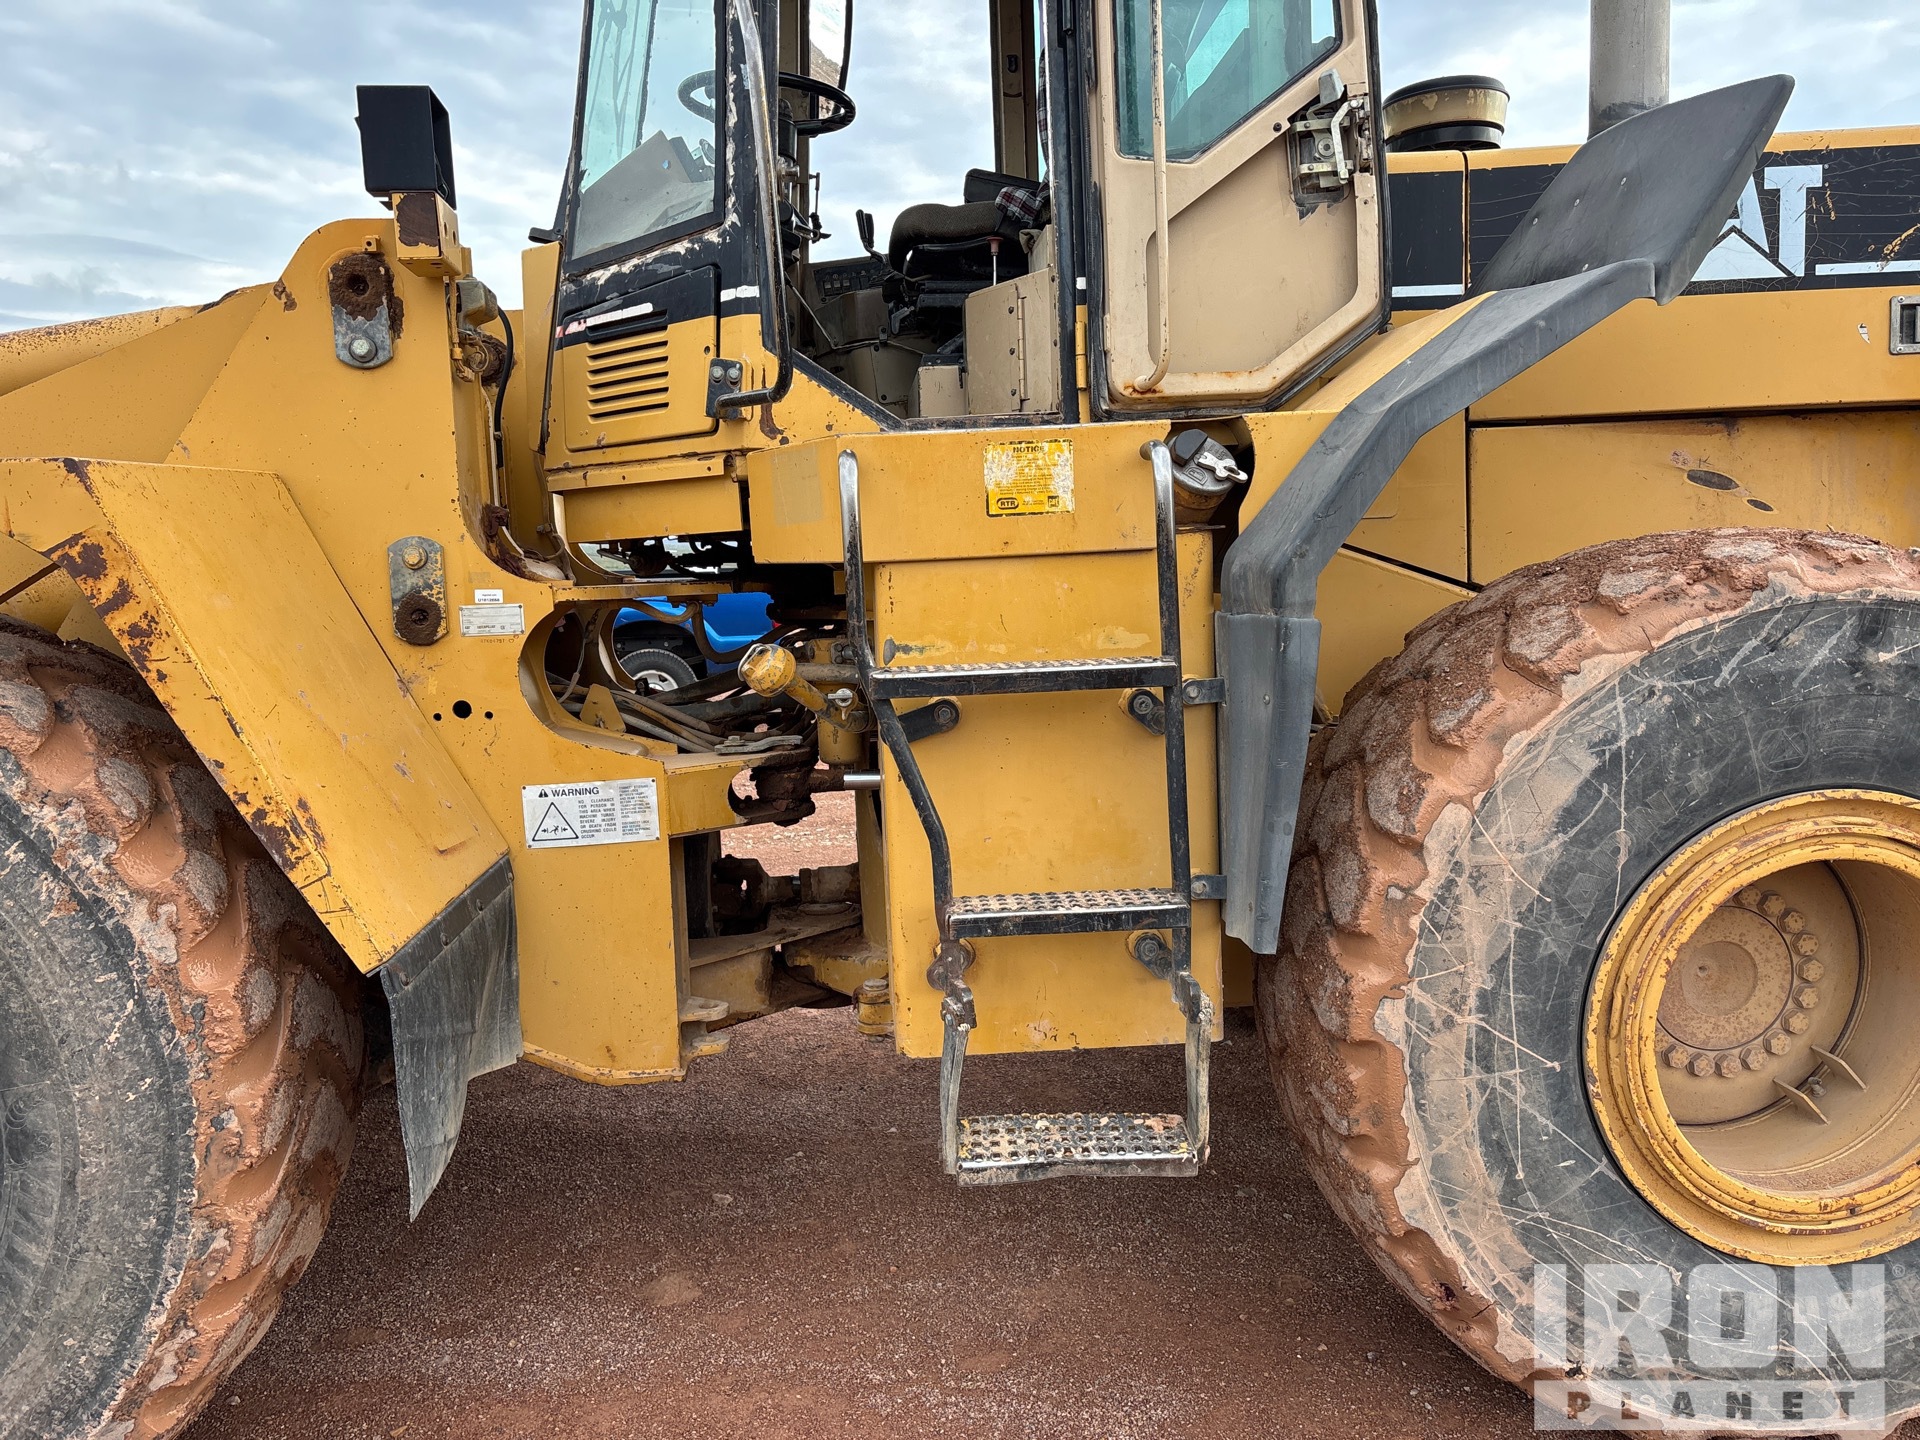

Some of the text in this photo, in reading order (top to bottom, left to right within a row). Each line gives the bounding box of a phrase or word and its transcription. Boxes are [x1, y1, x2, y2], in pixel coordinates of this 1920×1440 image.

[1702, 164, 1823, 277] AT
[1012, 445, 1045, 454] NOTICE
[551, 787, 600, 798] WARNING
